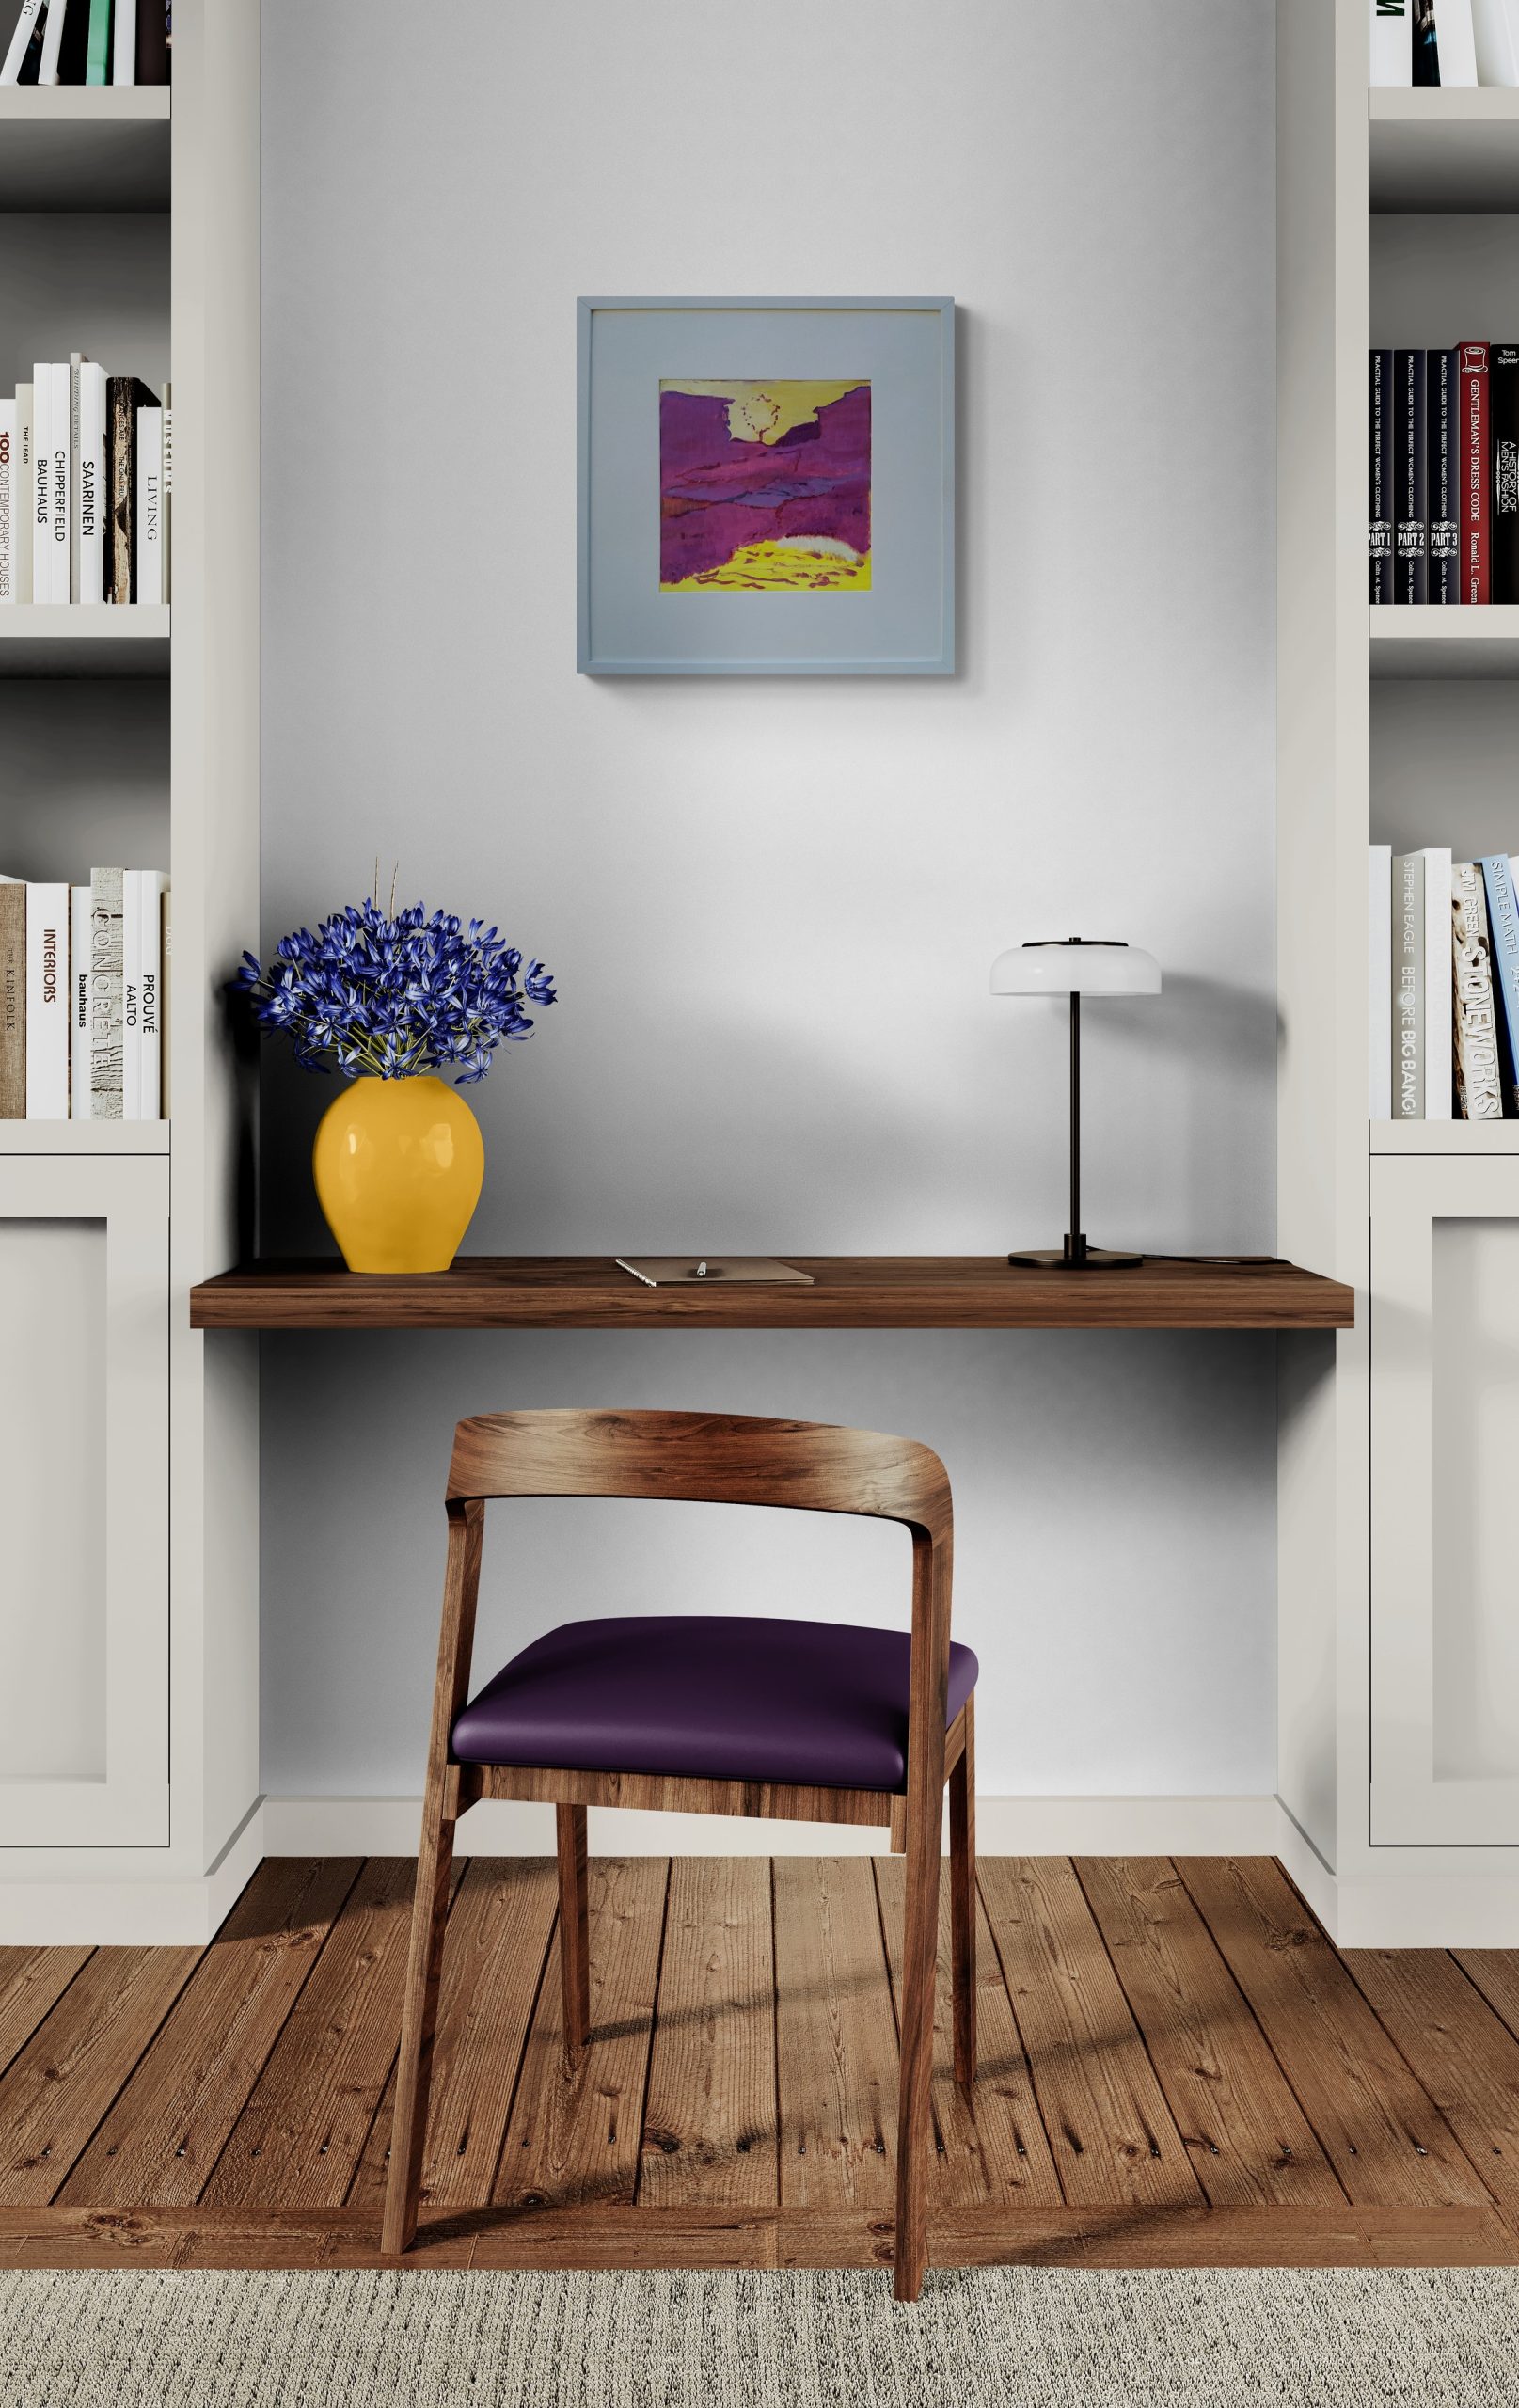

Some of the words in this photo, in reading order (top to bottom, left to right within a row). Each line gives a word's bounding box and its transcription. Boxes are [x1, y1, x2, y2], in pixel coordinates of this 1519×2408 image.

[1374, 407, 1381, 417] TO
[1408, 407, 1414, 417] TO
[1441, 407, 1447, 417] TO
[1508, 441, 1516, 450] A
[37, 459, 48, 524] BAUHAUS
[1470, 456, 1479, 489] DRESS
[1508, 452, 1516, 495] HISTORY
[55, 451, 66, 542] CHIPPERFIELD
[83, 461, 95, 536] SAARINEN
[147, 476, 158, 541] LIVING
[1470, 492, 1479, 521] CODE
[1508, 497, 1516, 511] OF
[1398, 532, 1418, 546] PART
[1419, 532, 1425, 546] 2
[1431, 532, 1450, 546] PART
[1452, 532, 1458, 546] 3
[1470, 532, 1479, 562] Ronald
[0, 553, 10, 596] HOUSES
[1470, 565, 1479, 575] L.
[1470, 577, 1479, 604] Green
[1403, 861, 1415, 911] STEPHEN
[1460, 870, 1477, 892] JIM
[1491, 862, 1511, 911] SIMPLE
[1403, 914, 1415, 954] EAGLE
[1464, 899, 1480, 939] GREEN
[1500, 911, 1518, 955] MATH
[43, 929, 56, 1003] INTERIORS
[92, 908, 112, 1064] CONCRETE
[6, 969, 15, 1031] KINFOLK
[78, 974, 88, 1028] bauhaus
[126, 984, 137, 1026] AALTO
[143, 974, 158, 1034] PROUVÉ
[1402, 966, 1416, 1025] BEFORE
[1401, 1030, 1416, 1057] BIG
[1462, 945, 1500, 1114] STONEWORKS
[1401, 1059, 1416, 1115] BANG!
